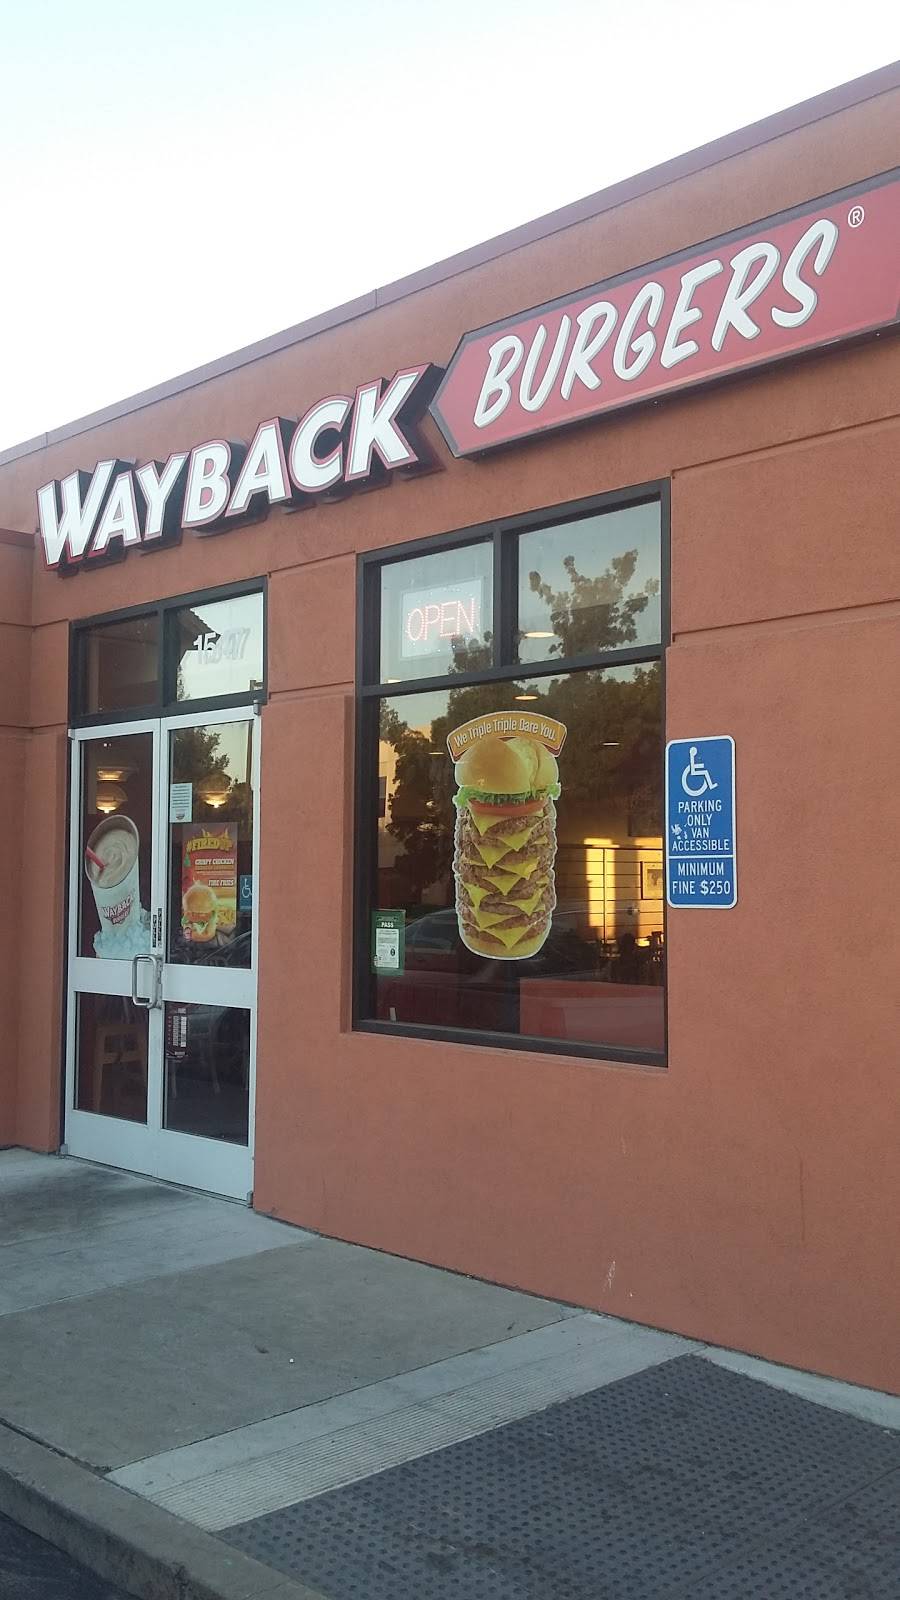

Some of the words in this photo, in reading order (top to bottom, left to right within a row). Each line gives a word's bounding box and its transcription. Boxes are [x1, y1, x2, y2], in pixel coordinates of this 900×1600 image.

[473, 218, 839, 429] BURGERS
[37, 363, 430, 569] WAYBACK
[407, 597, 476, 641] OPEN
[454, 734, 468, 747] We
[468, 722, 492, 739] Triple
[493, 718, 517, 734] Triple
[518, 719, 539, 734] Dare
[539, 723, 556, 741] You.
[678, 800, 722, 813] PARKING
[687, 814, 712, 826] ONLY
[691, 827, 710, 838] VAN
[671, 839, 730, 851] ACCESSIBLE
[677, 862, 724, 876] MINIMUM
[672, 880, 696, 895] FINE
[700, 879, 731, 896] $250
